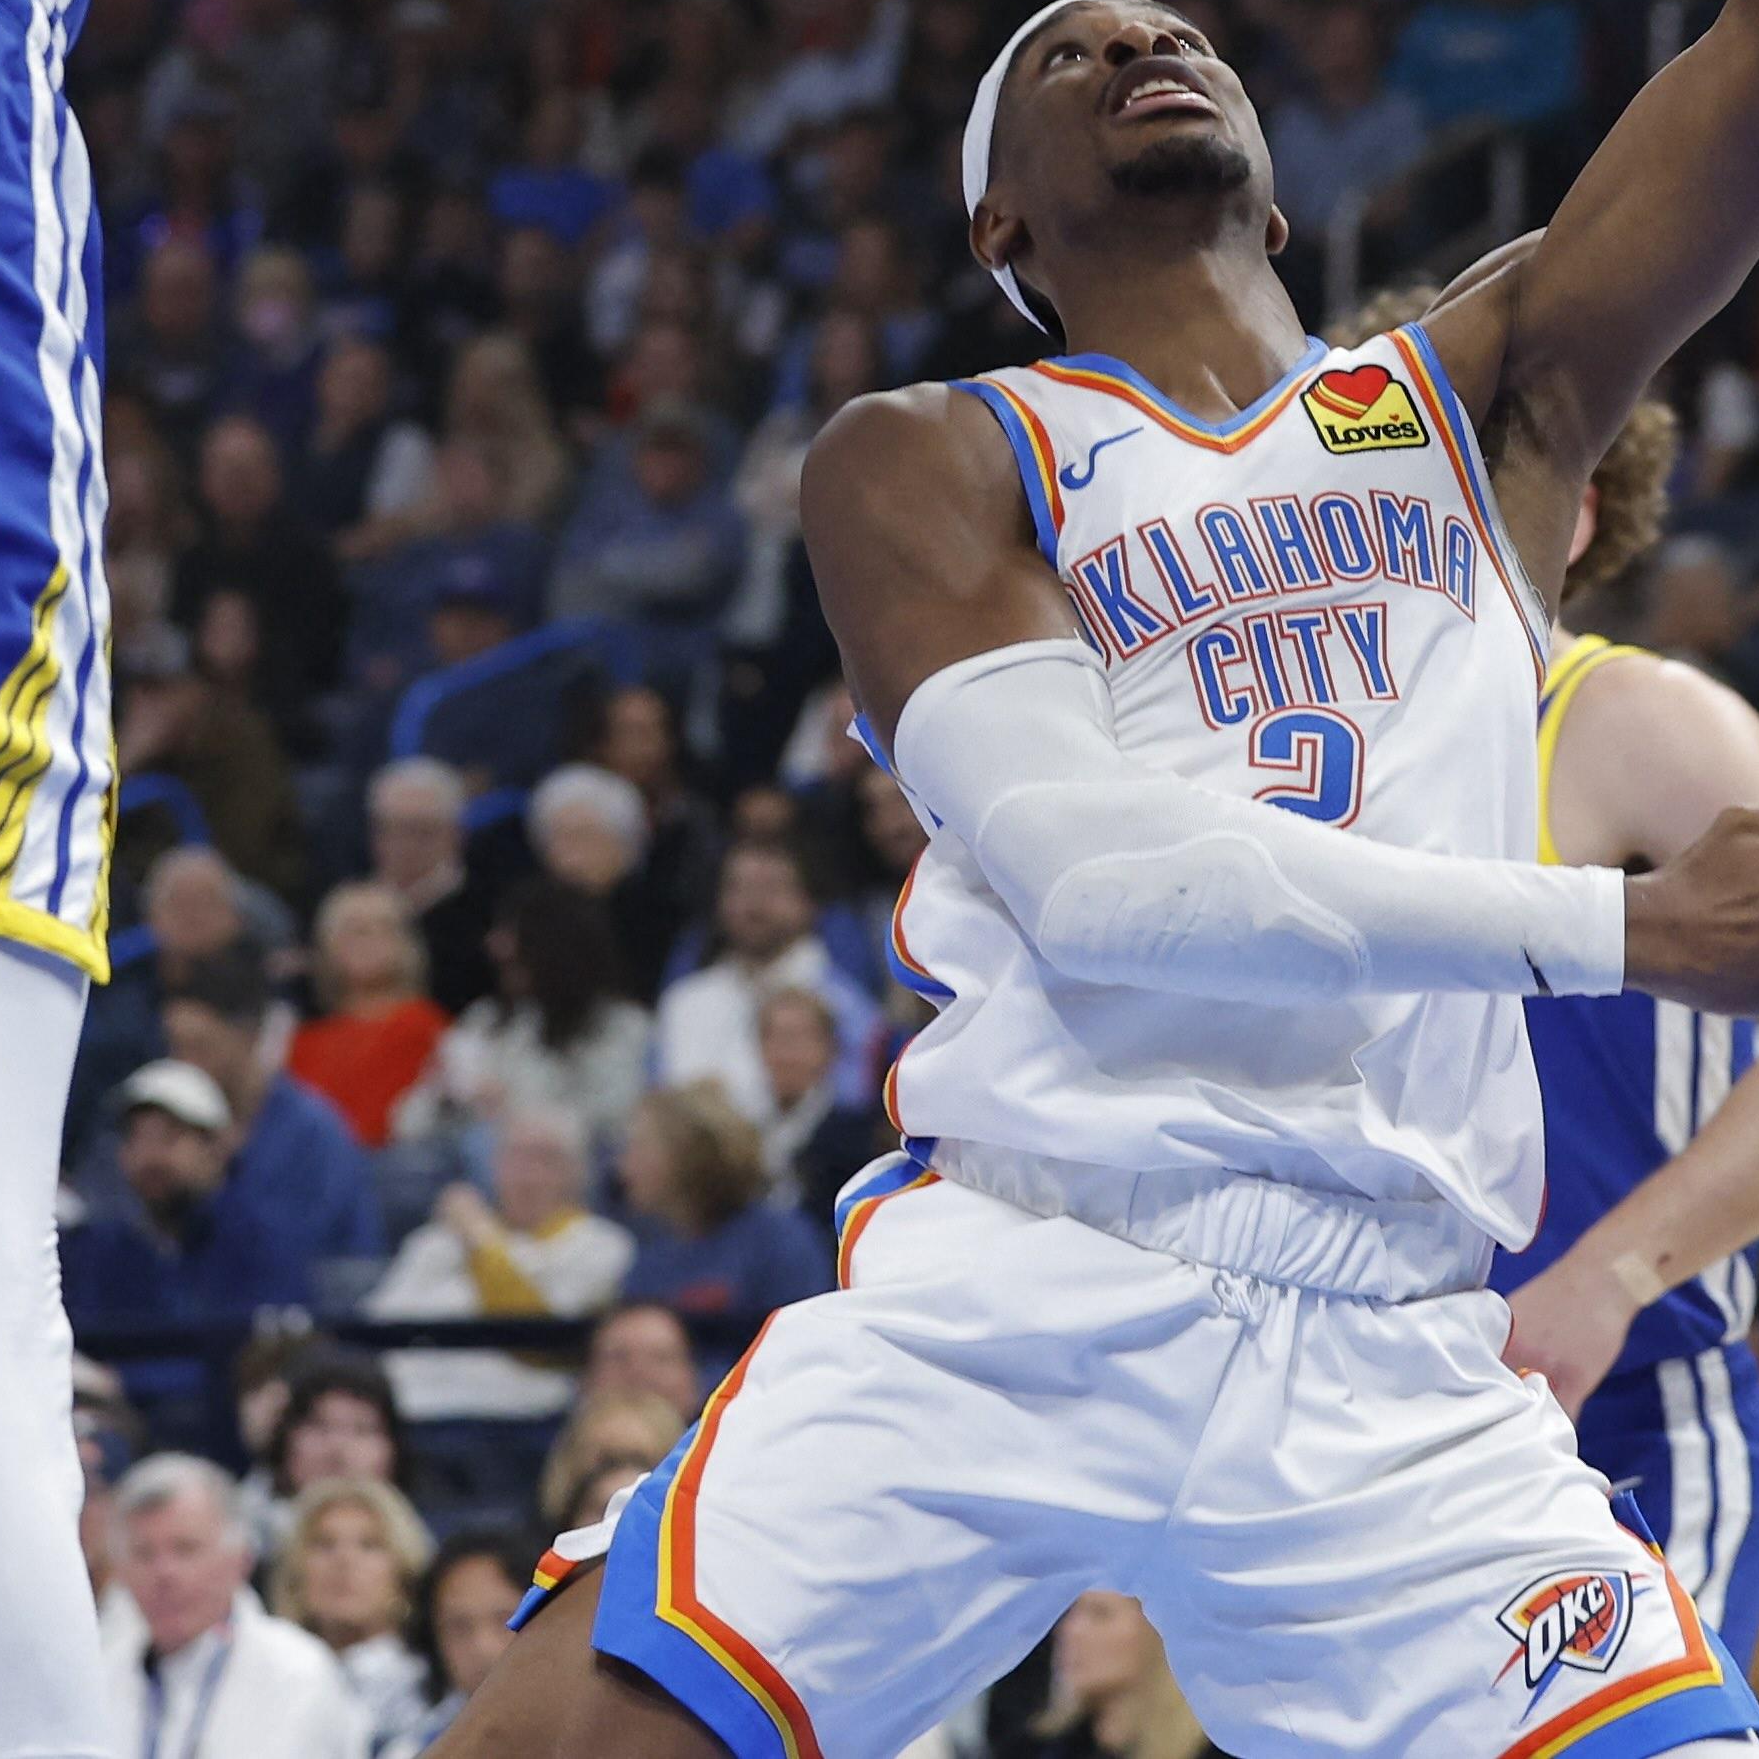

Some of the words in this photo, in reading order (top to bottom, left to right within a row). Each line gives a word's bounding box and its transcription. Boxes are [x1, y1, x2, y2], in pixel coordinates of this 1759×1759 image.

[1065, 490, 1478, 670] KLAHOMA
[1187, 601, 1399, 731] CITY
[1248, 704, 1366, 830] 2
[1525, 1577, 1606, 1689] OKC
